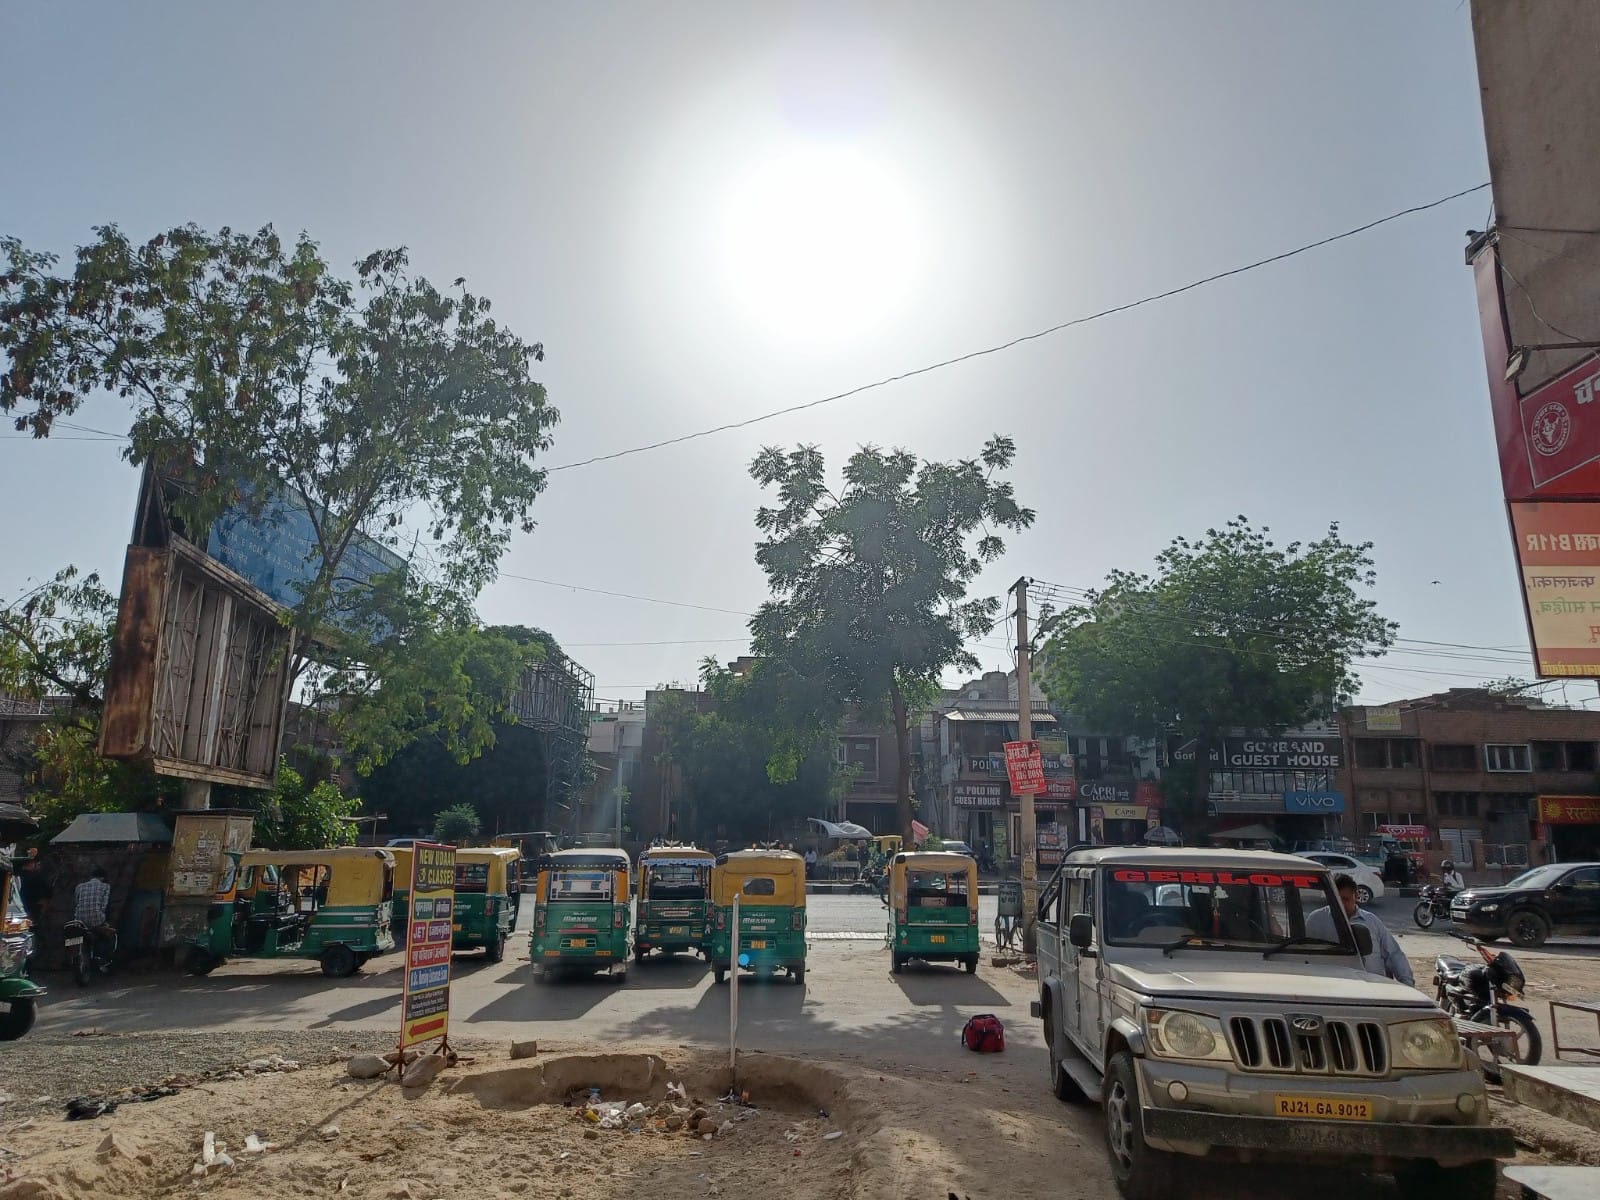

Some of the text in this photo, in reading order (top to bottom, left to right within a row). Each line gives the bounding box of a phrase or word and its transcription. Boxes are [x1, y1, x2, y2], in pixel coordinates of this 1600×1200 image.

[1231, 755, 1339, 766] GUEST HOUSE
[966, 786, 985, 795] POLO
[954, 796, 1001, 806] GUEST HOUSE
[1296, 795, 1335, 808] vivo
[420, 849, 455, 867] NEW UDAAN
[428, 869, 454, 885] CLASSES
[1114, 870, 1319, 888] GEHLOT
[413, 926, 426, 939] JET
